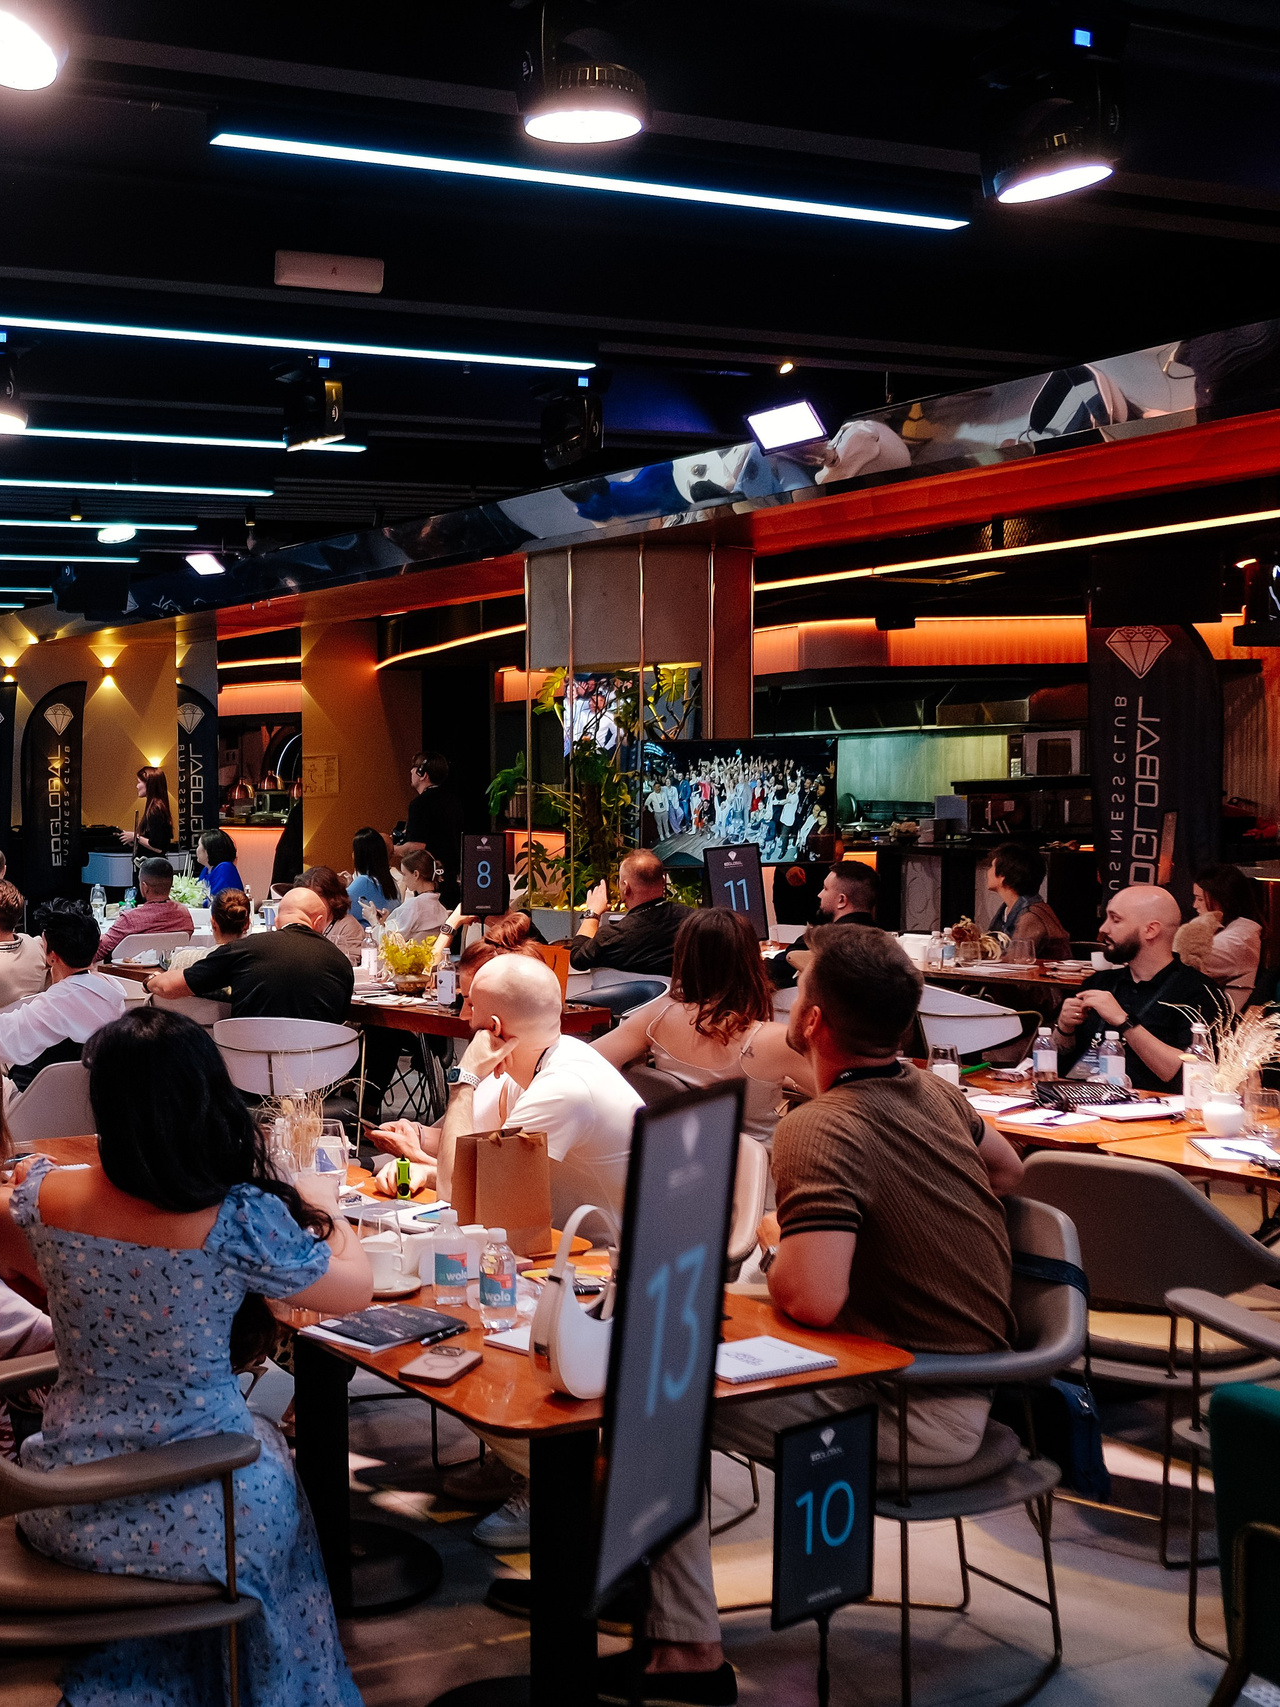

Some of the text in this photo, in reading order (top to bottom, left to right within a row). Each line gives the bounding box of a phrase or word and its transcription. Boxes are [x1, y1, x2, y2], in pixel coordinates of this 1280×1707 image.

[63, 746, 71, 785] CLUB
[47, 745, 62, 867] EDGLOBAL
[476, 860, 491, 888] 8
[723, 879, 749, 911] 11
[485, 1291, 511, 1302] wola
[646, 1244, 706, 1418] 13
[795, 1480, 855, 1555] 10
